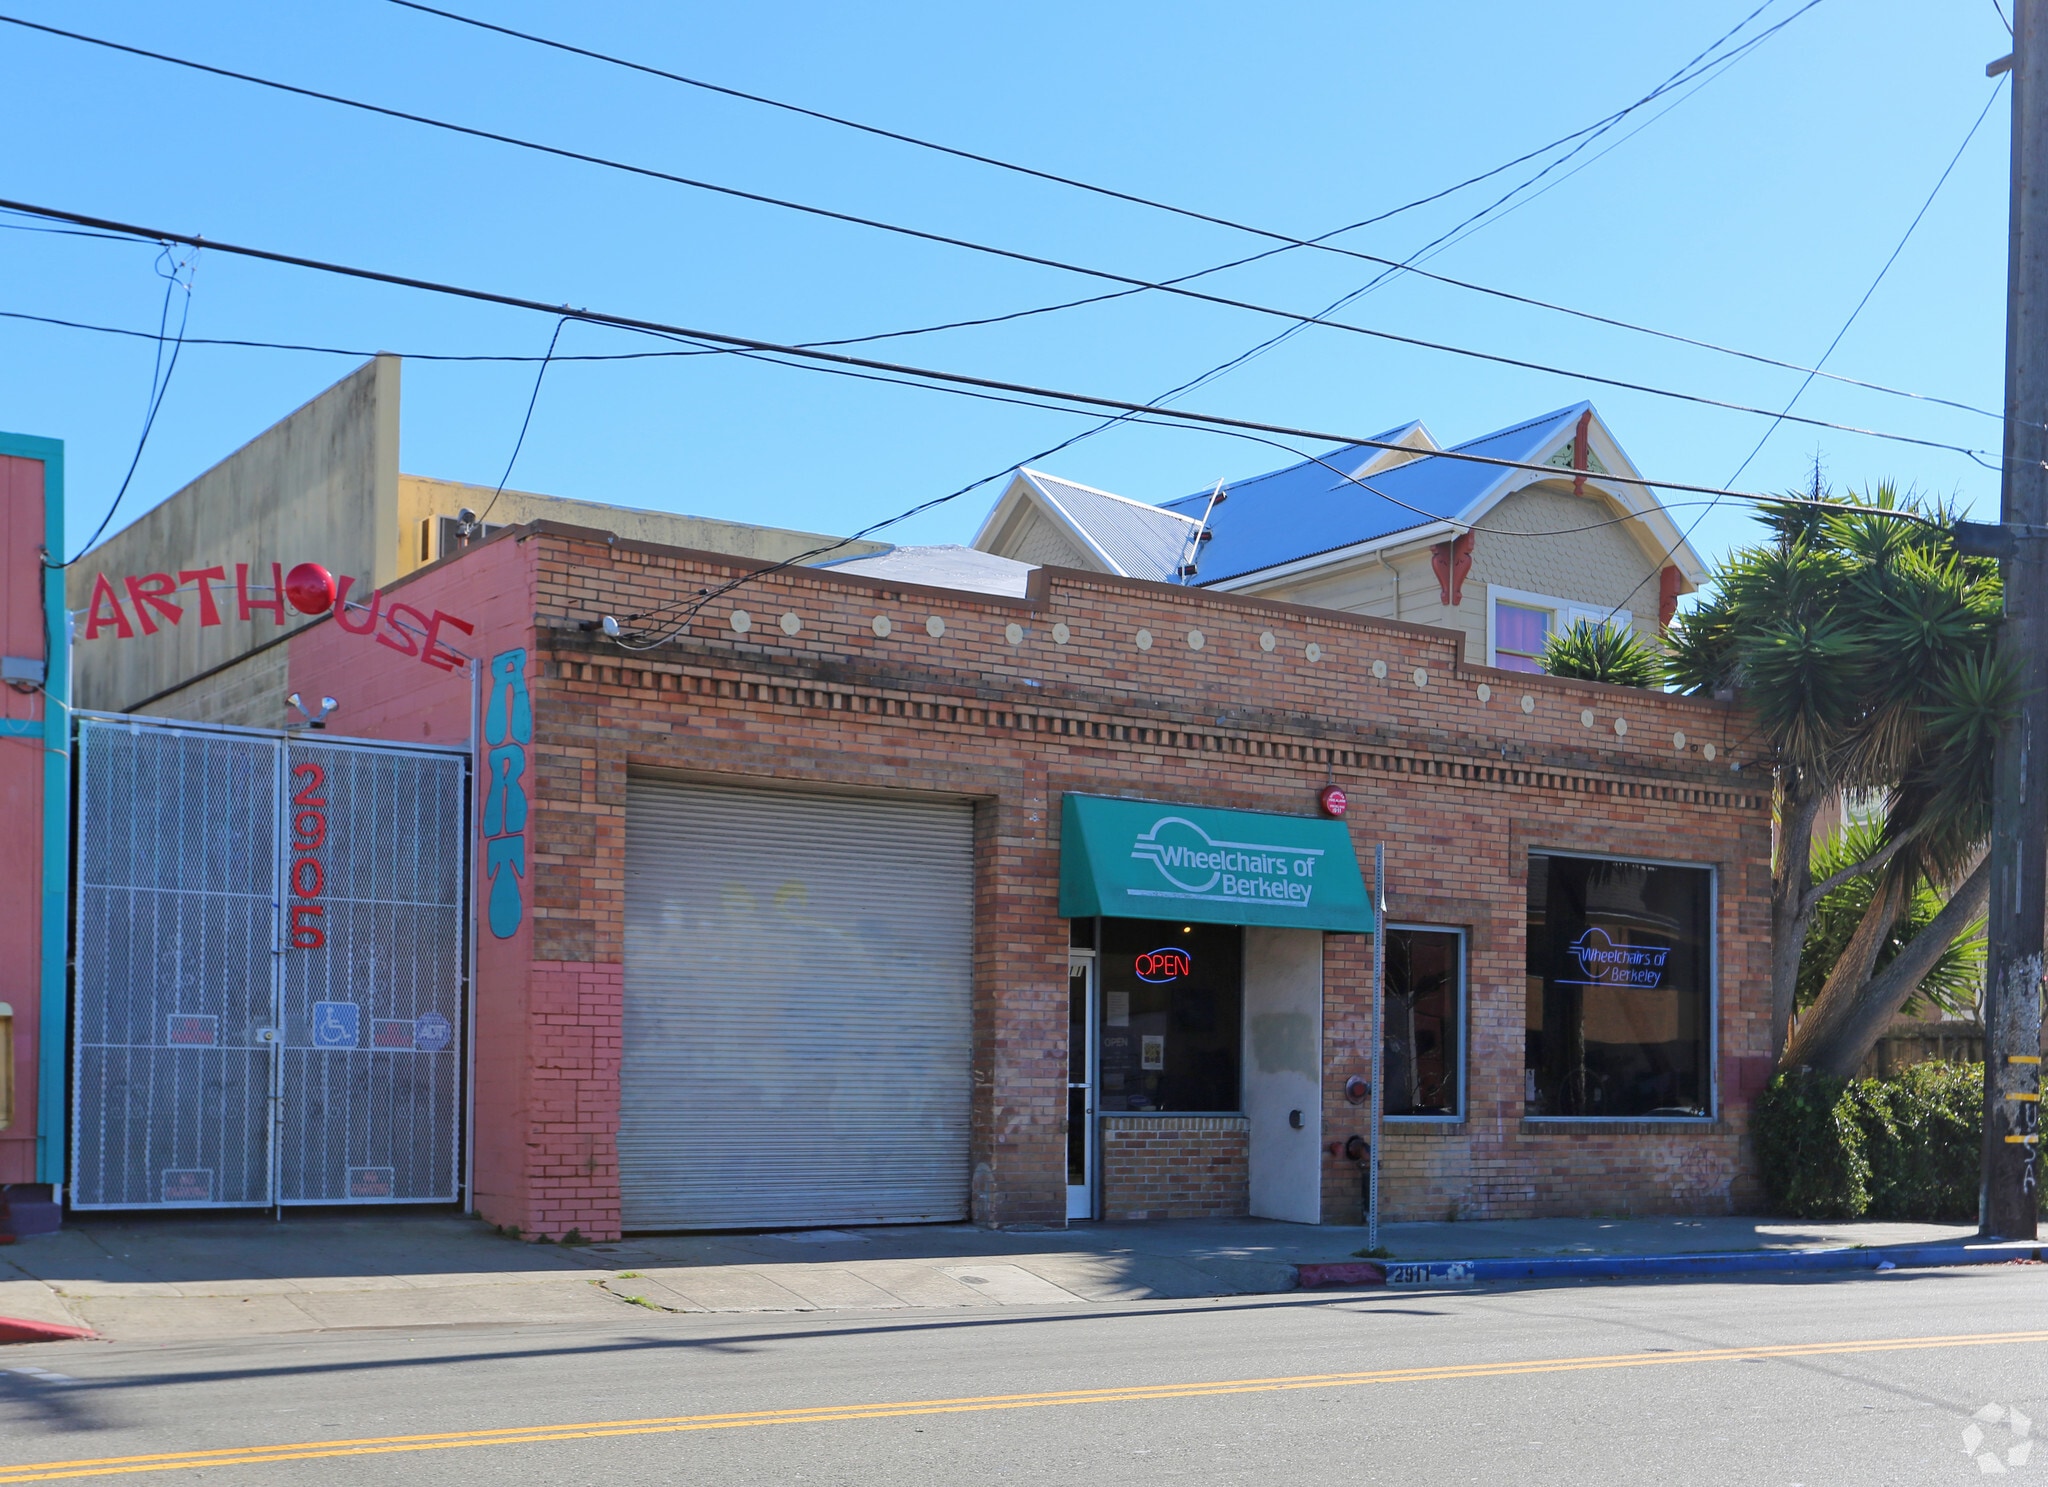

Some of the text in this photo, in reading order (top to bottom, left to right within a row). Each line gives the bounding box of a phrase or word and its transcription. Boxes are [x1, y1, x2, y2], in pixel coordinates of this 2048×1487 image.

[86, 563, 474, 671] ARTHOUSE
[484, 648, 532, 939] ART
[292, 763, 326, 948] 2905
[1161, 845, 1316, 878] Wheelchairs of
[1222, 873, 1313, 904] Berkeley
[1135, 954, 1189, 976] OPEN
[1582, 947, 1668, 967] Wheelchairs of
[1611, 966, 1661, 985] Berkeley
[1395, 1265, 1430, 1283] 2911
